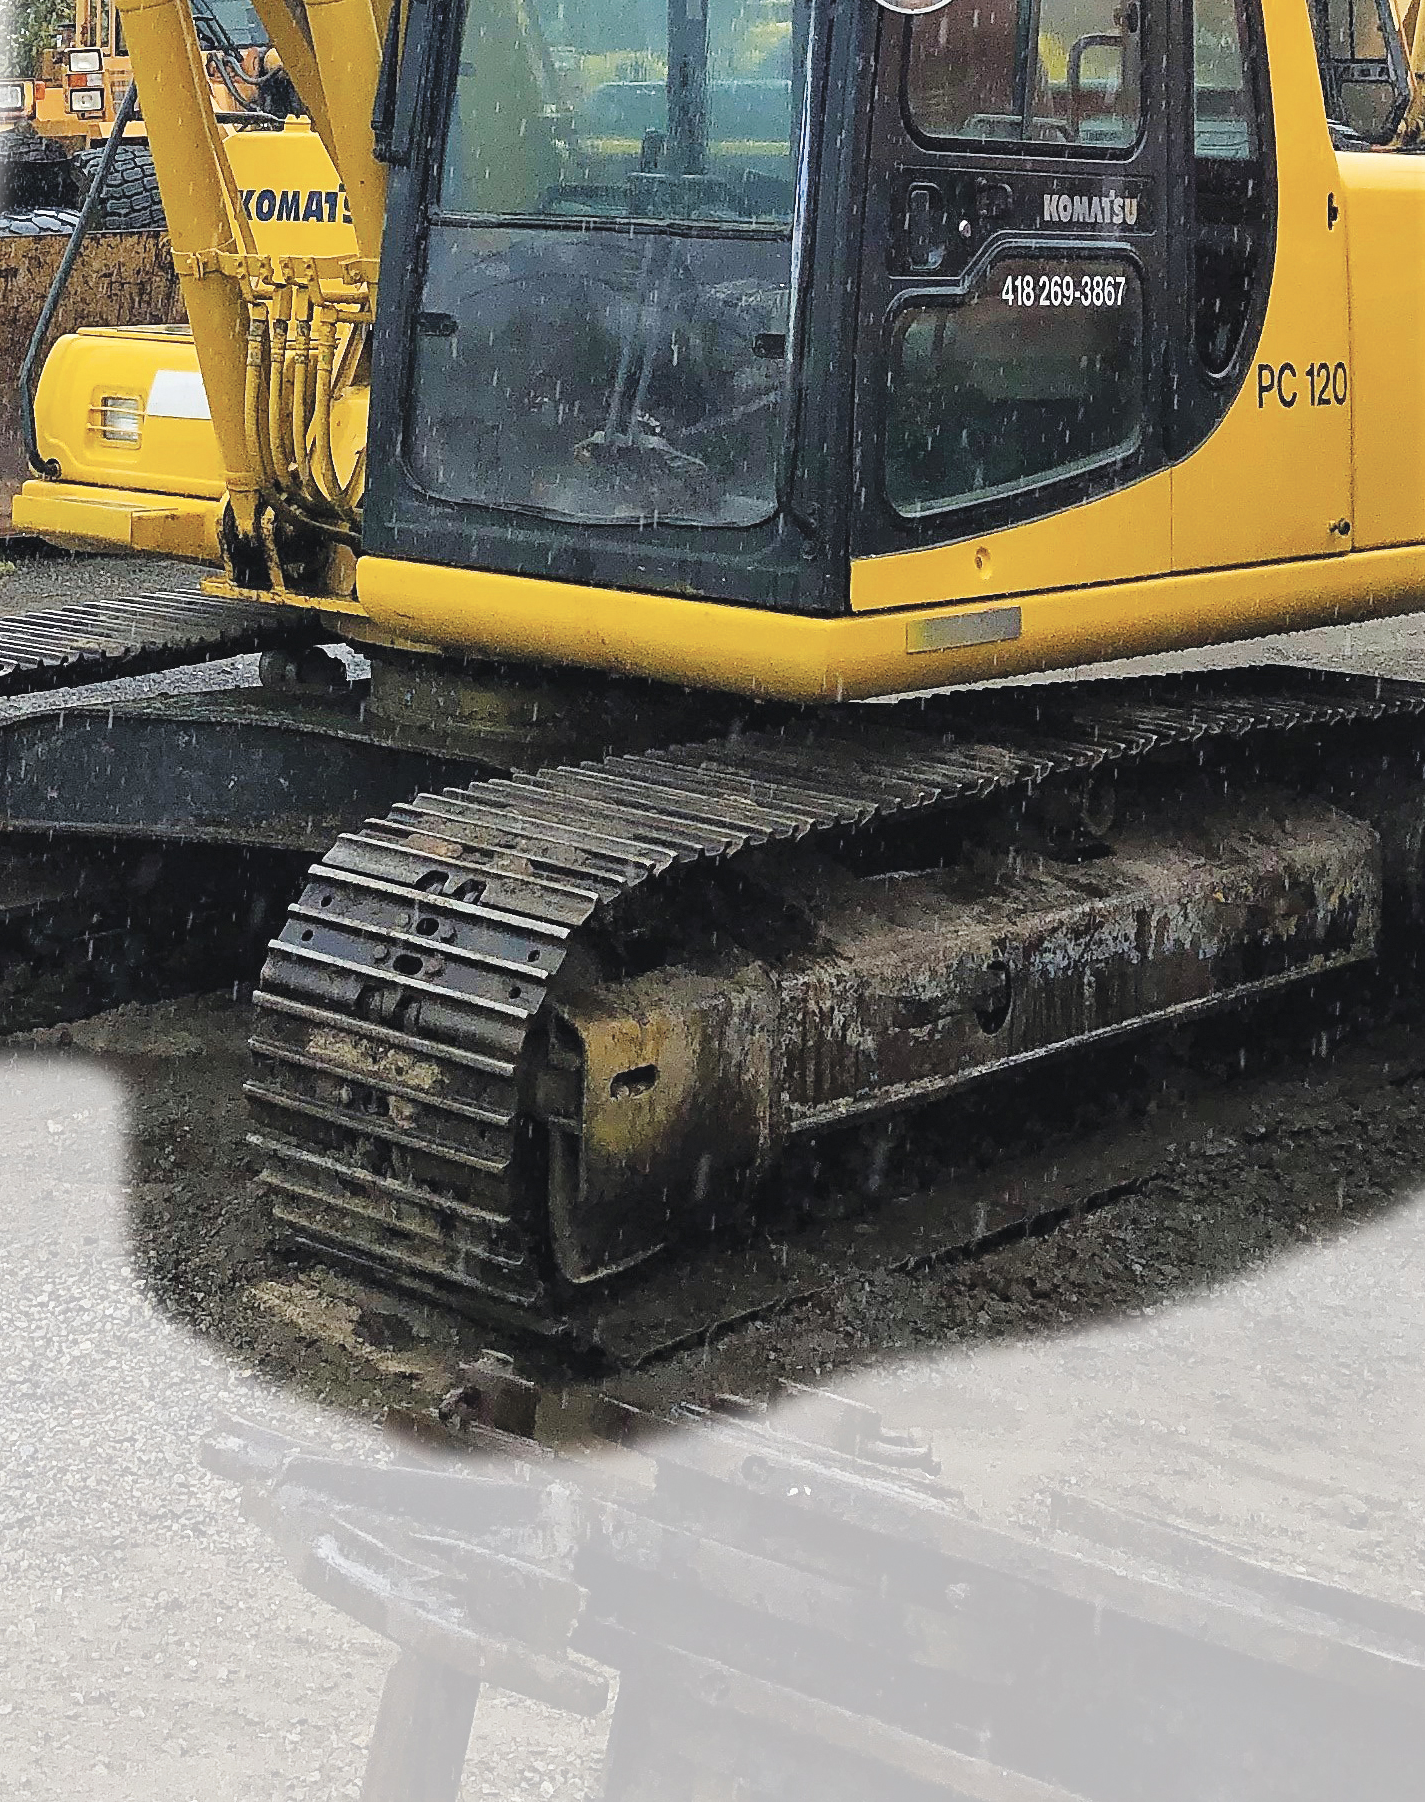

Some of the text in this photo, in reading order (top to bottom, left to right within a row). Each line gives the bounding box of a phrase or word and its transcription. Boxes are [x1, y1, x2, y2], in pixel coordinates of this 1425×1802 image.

[1043, 189, 1138, 224] KOMATSU
[1002, 275, 1126, 307] 418 269-3867
[1258, 361, 1347, 409] PC 120
